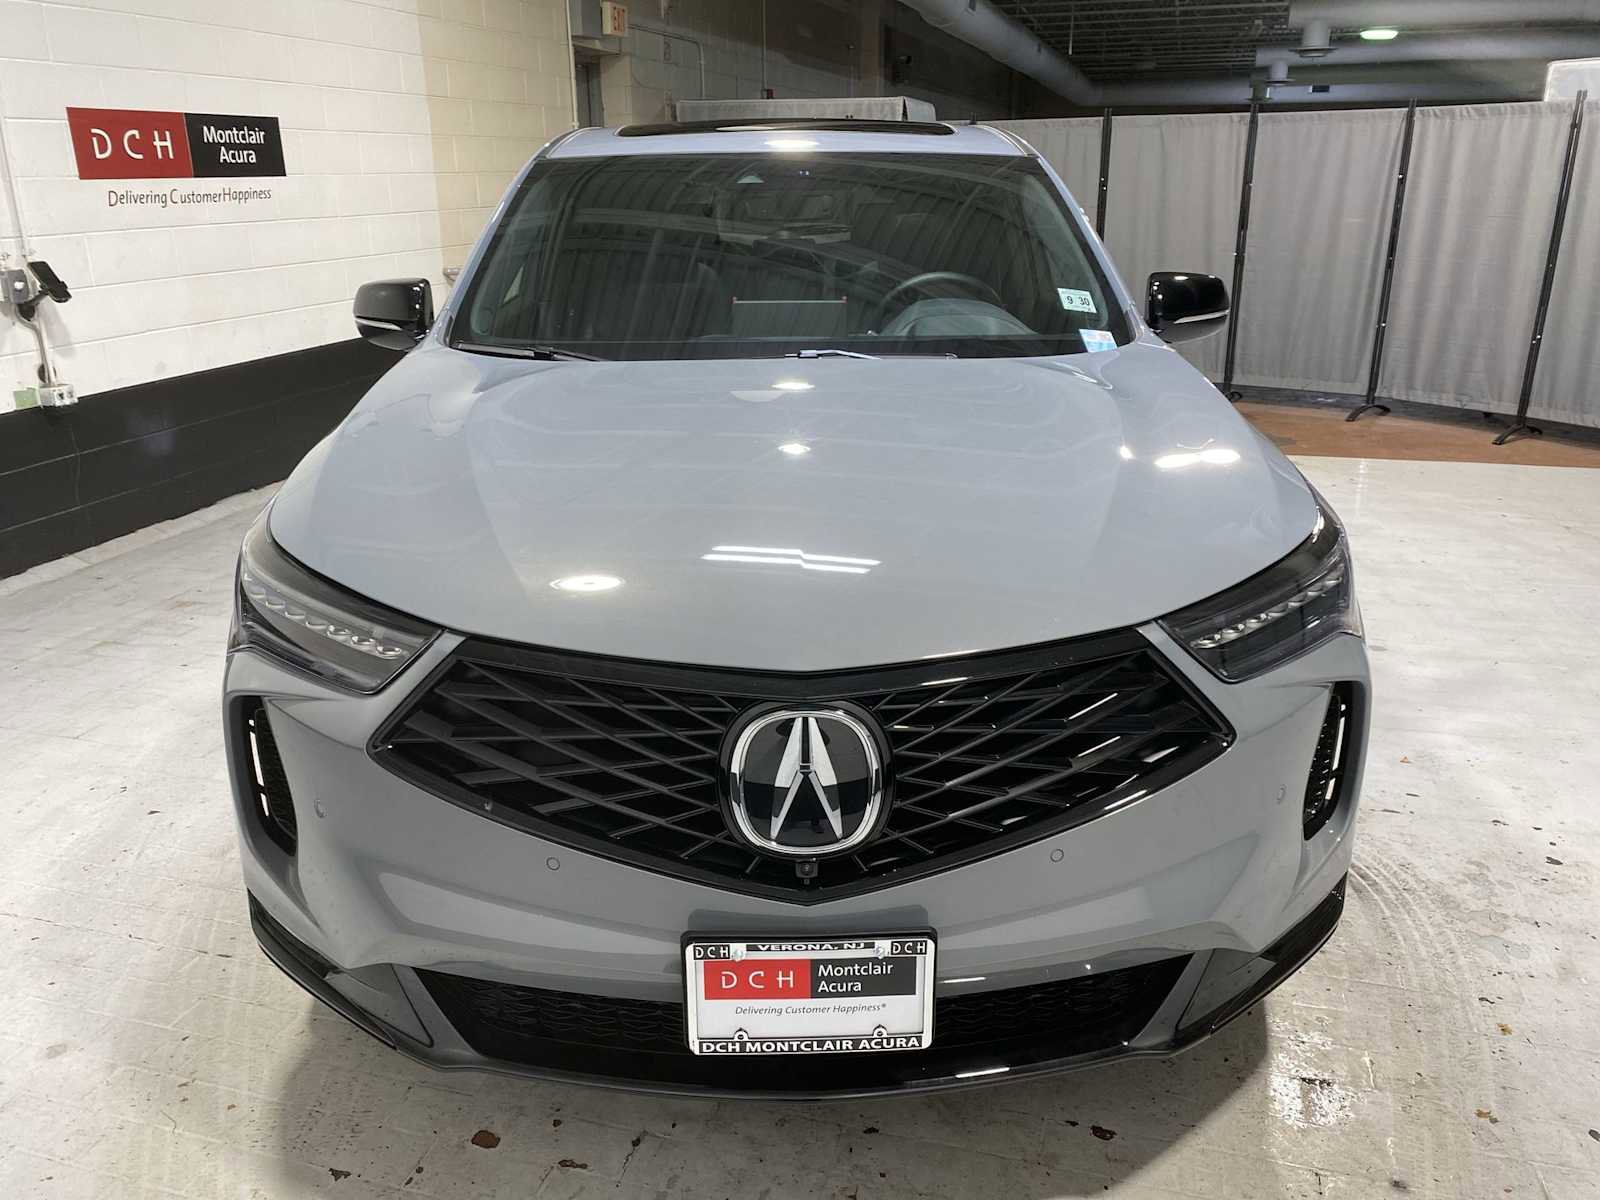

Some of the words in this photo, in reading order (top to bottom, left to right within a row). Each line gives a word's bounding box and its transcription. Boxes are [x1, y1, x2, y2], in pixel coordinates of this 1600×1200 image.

[202, 126, 265, 145] Montclair
[90, 128, 174, 160] DCH
[219, 146, 257, 164] Acura
[108, 189, 168, 208] Delivering
[169, 188, 222, 204] Customer
[222, 186, 272, 203] Happiness
[1079, 296, 1090, 306] 30
[694, 946, 730, 959] DCH
[757, 943, 839, 951] VERONA,
[892, 942, 927, 955] DCH
[818, 962, 894, 977] Montclair
[721, 970, 794, 989] DCH
[817, 980, 863, 993] Acura
[735, 1005, 783, 1017] Delivering
[785, 1005, 831, 1014] Customer
[702, 1041, 741, 1052] DCH
[746, 1039, 855, 1052] MONTCLAIR
[858, 1036, 920, 1050] ACURA
